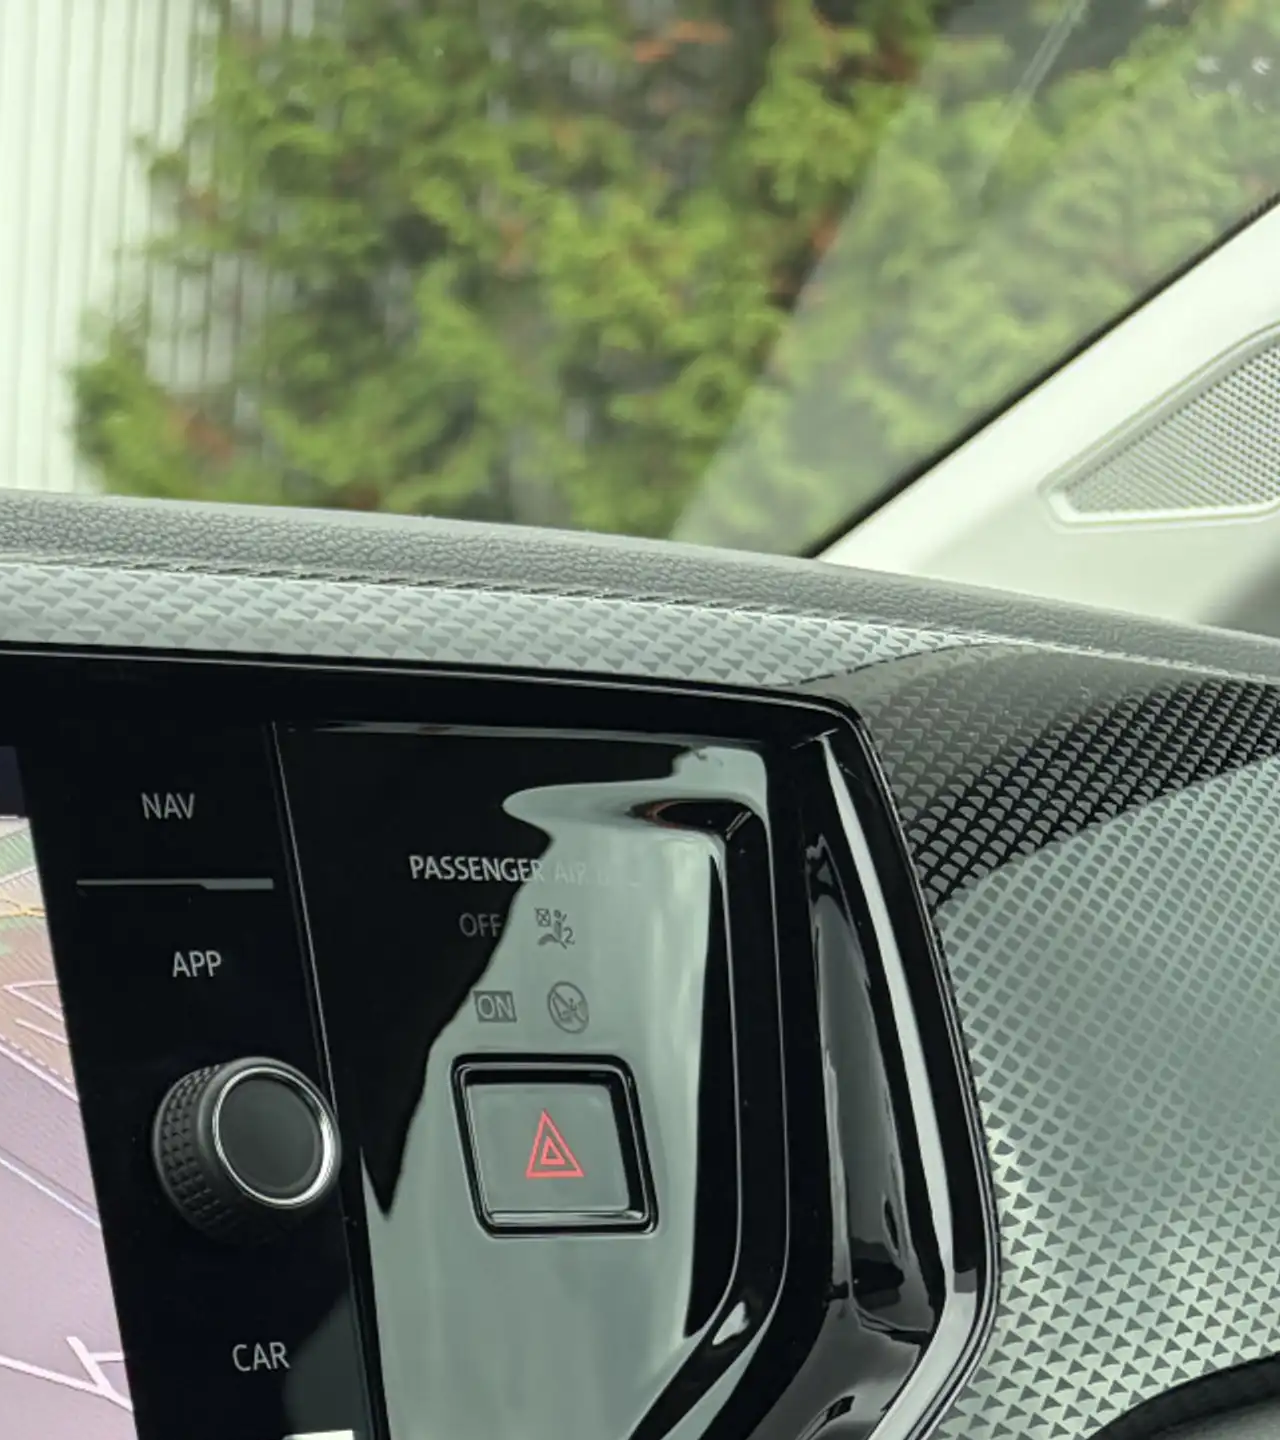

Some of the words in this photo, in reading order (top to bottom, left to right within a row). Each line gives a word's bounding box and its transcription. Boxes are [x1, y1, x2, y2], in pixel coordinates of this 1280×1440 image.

[141, 792, 195, 820] NAV
[409, 855, 545, 884] PASSENGER
[459, 912, 502, 938] OFF
[172, 949, 223, 978] APP
[476, 993, 515, 1020] ON
[231, 1341, 290, 1372] CAR
